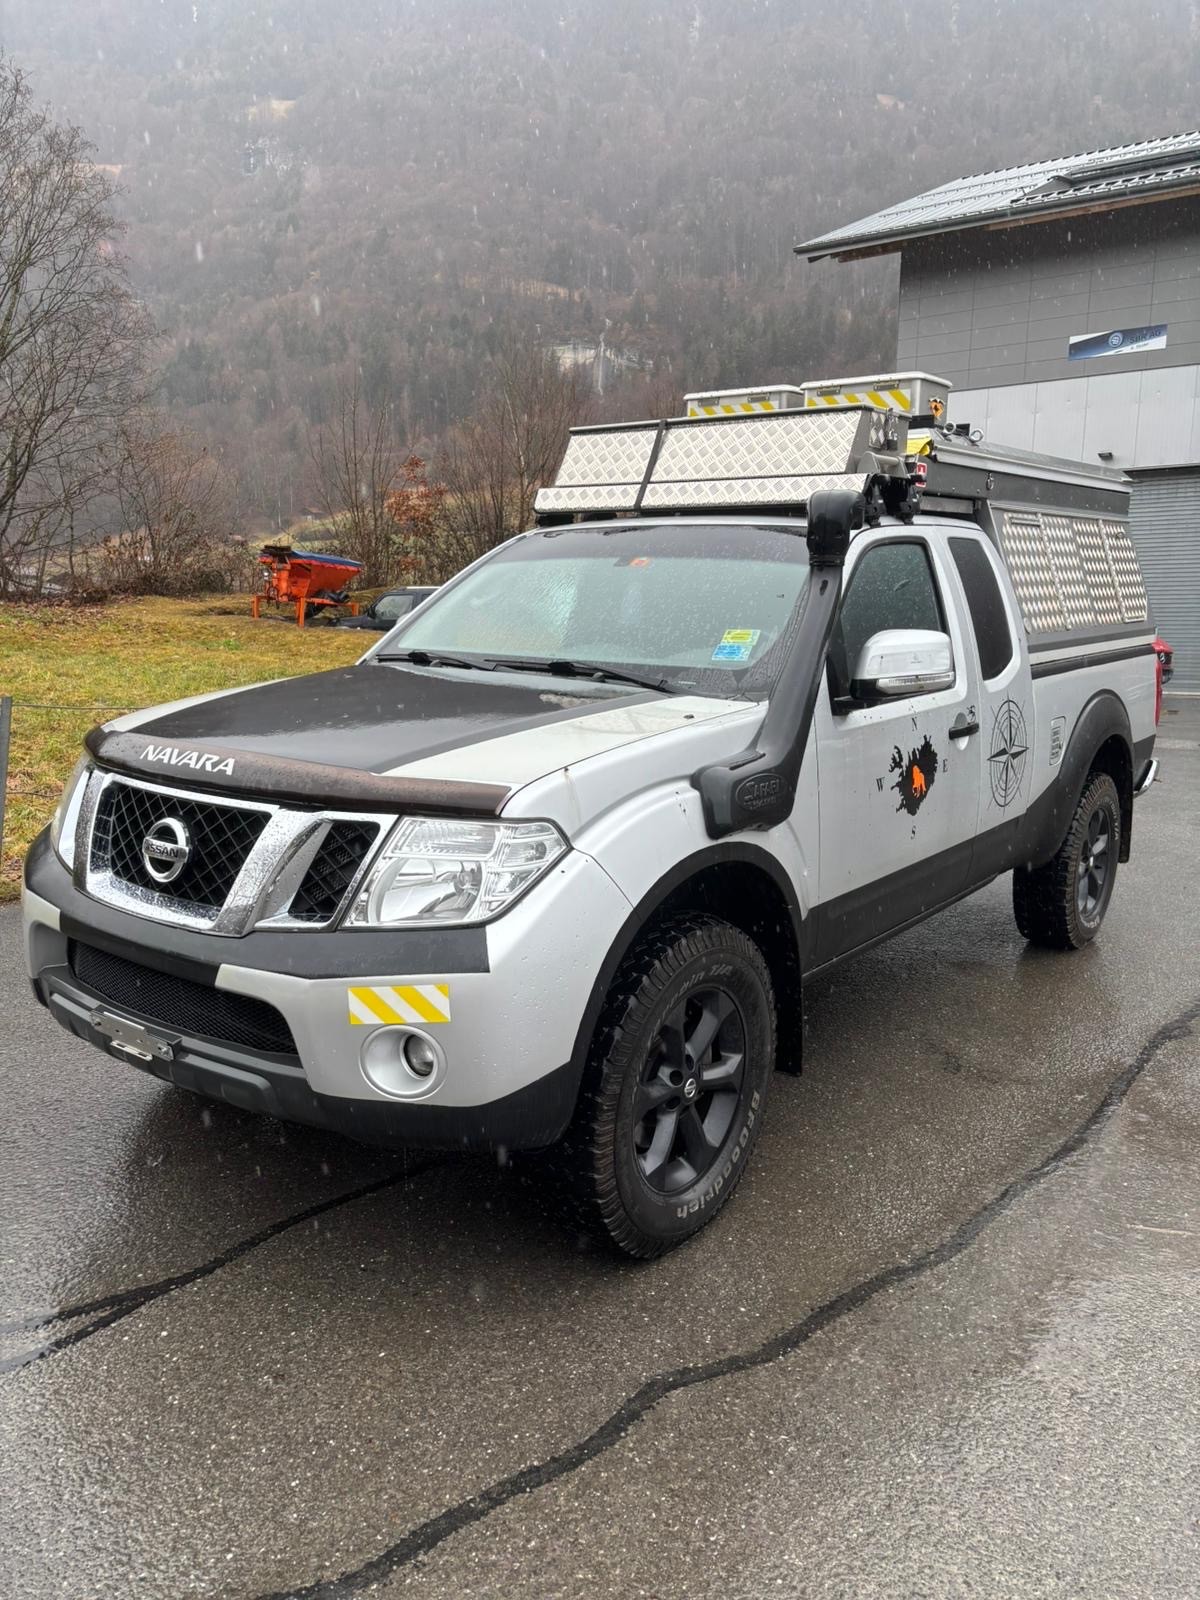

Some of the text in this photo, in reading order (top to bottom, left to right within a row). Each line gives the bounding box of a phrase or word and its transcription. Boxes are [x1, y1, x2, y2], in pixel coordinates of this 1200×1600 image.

[911, 717, 918, 732] N
[139, 744, 236, 776] NAVARA
[942, 758, 949, 773] E
[875, 776, 886, 792] W
[910, 824, 917, 840] S
